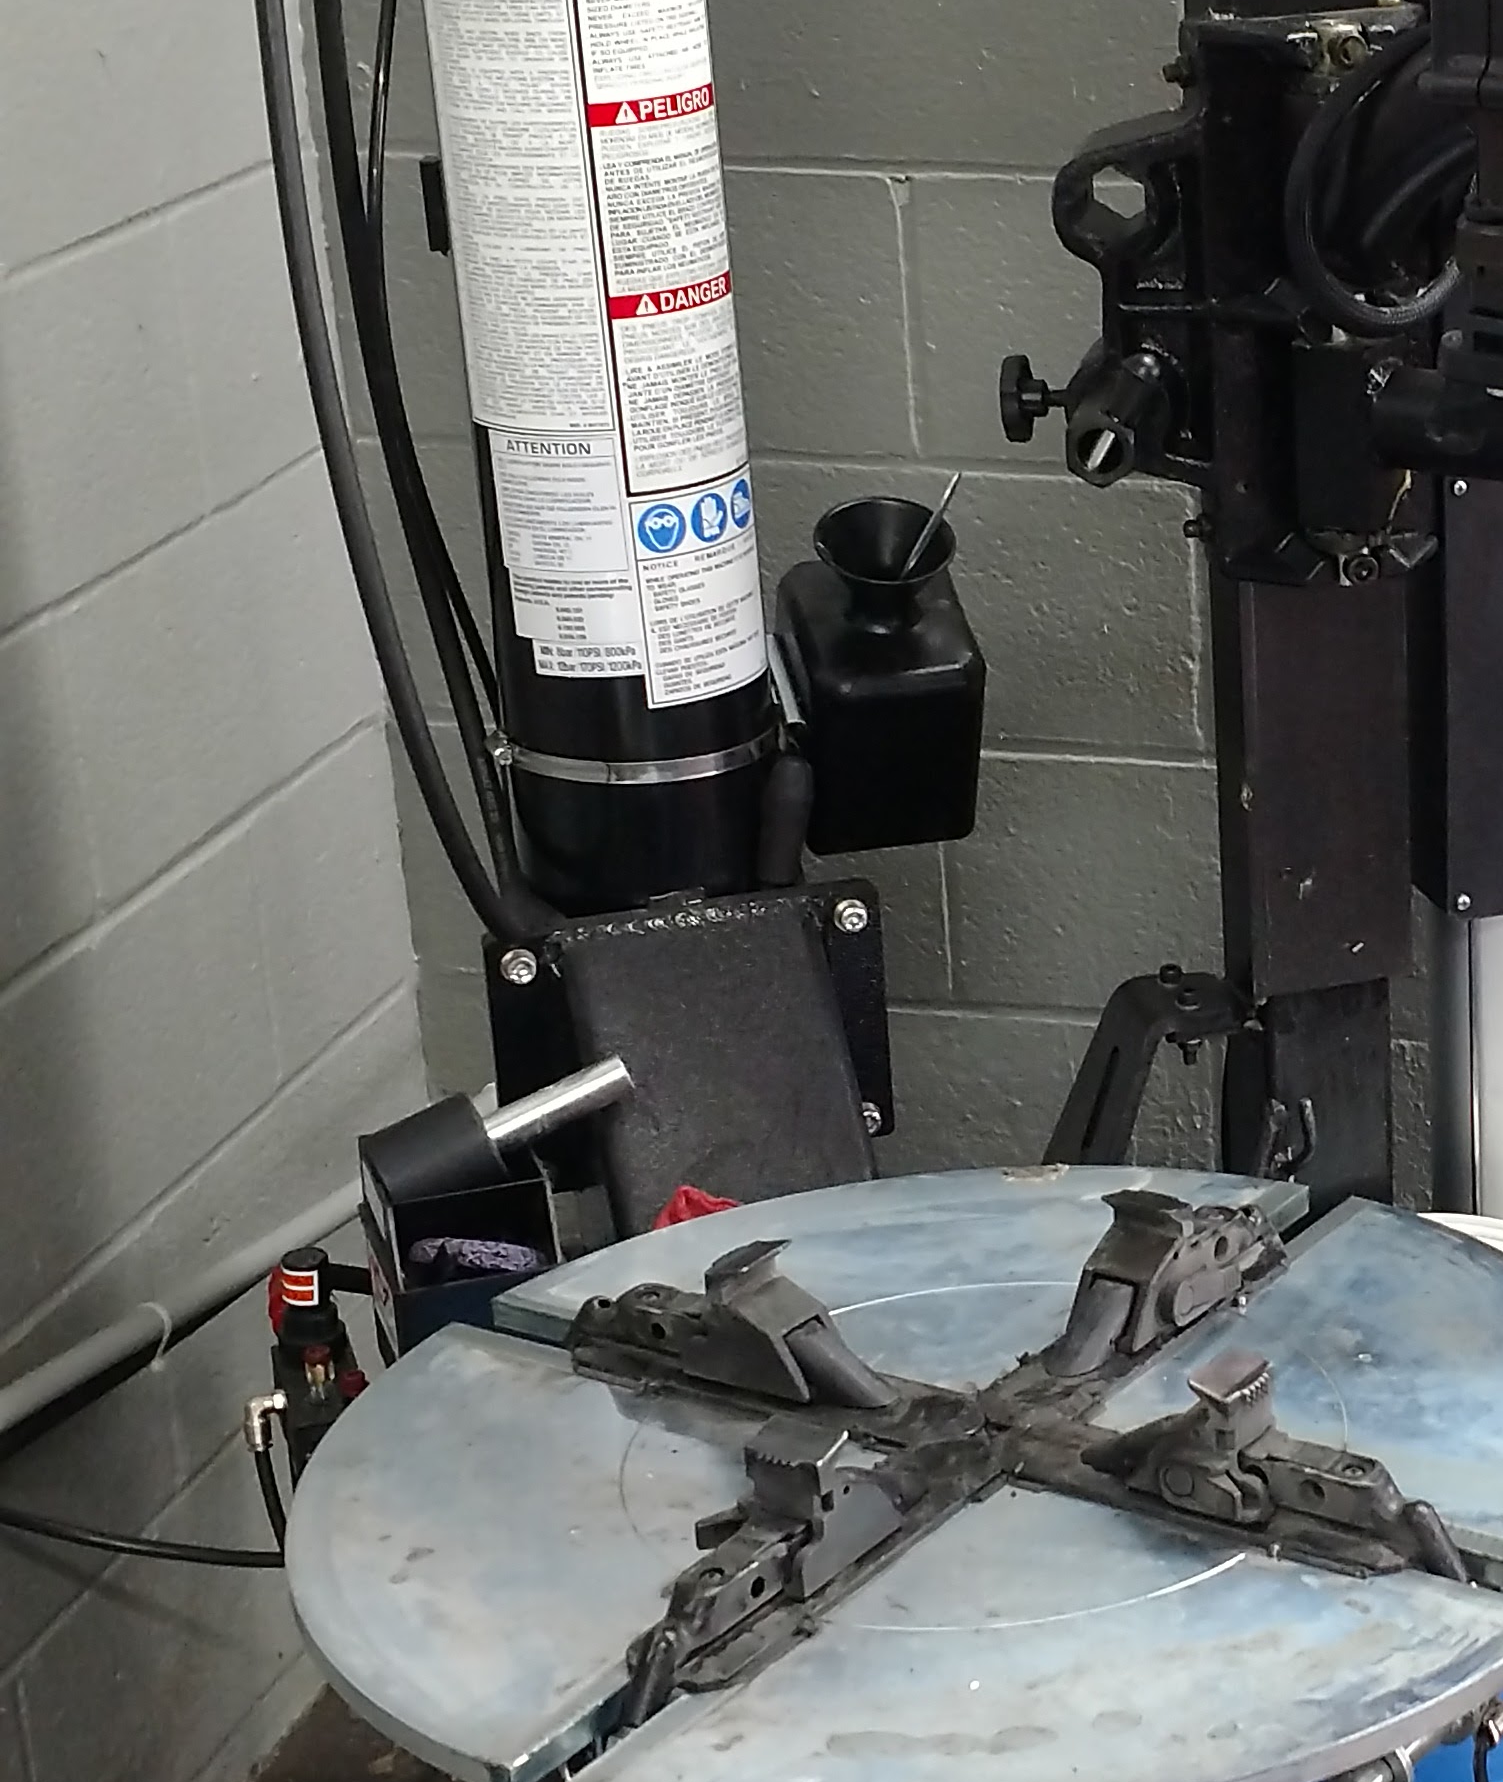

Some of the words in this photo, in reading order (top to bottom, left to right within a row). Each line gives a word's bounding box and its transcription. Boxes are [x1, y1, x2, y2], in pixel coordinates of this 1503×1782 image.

[639, 87, 709, 120] PELIGRO
[660, 277, 727, 311] DANGER
[506, 440, 591, 455] ATTENTION
[643, 561, 678, 571] NOTICE
